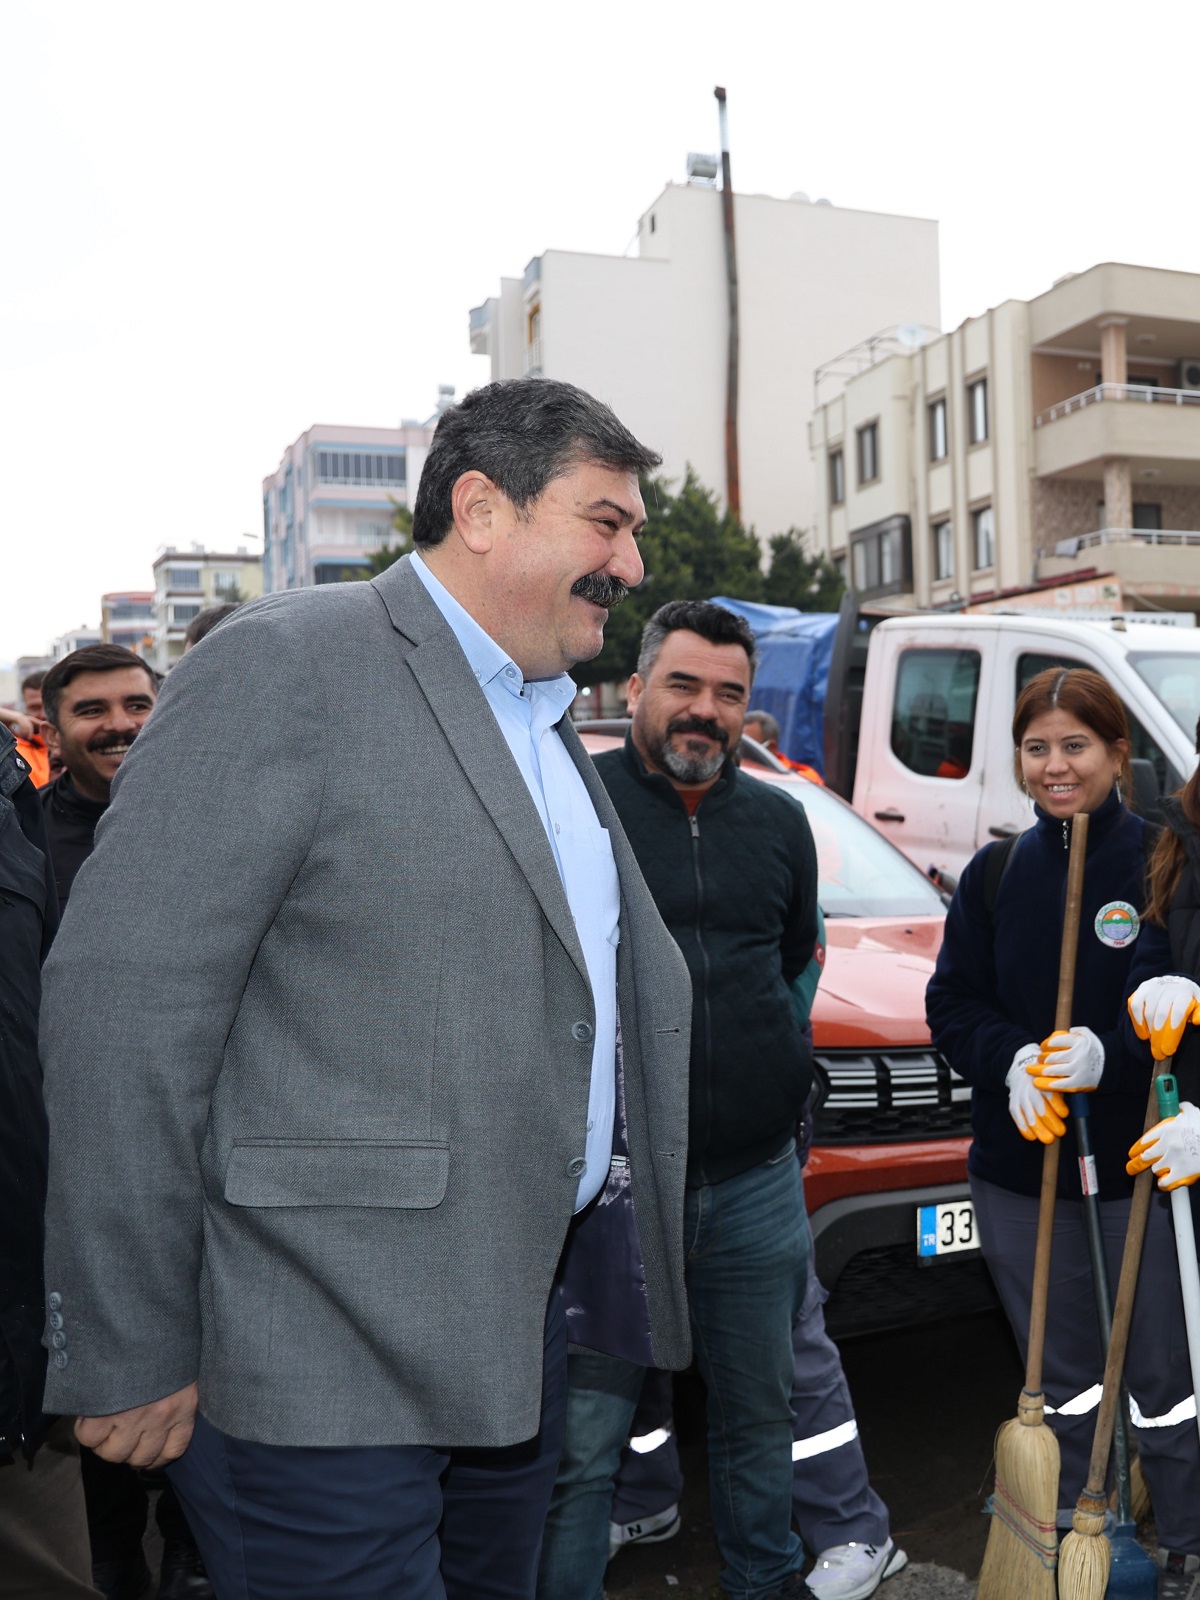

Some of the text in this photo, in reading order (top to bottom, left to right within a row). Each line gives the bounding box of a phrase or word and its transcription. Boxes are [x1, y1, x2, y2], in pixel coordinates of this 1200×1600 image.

[922, 1208, 973, 1247] TR 33
[627, 1523, 643, 1538] N
[864, 1543, 878, 1559] N
